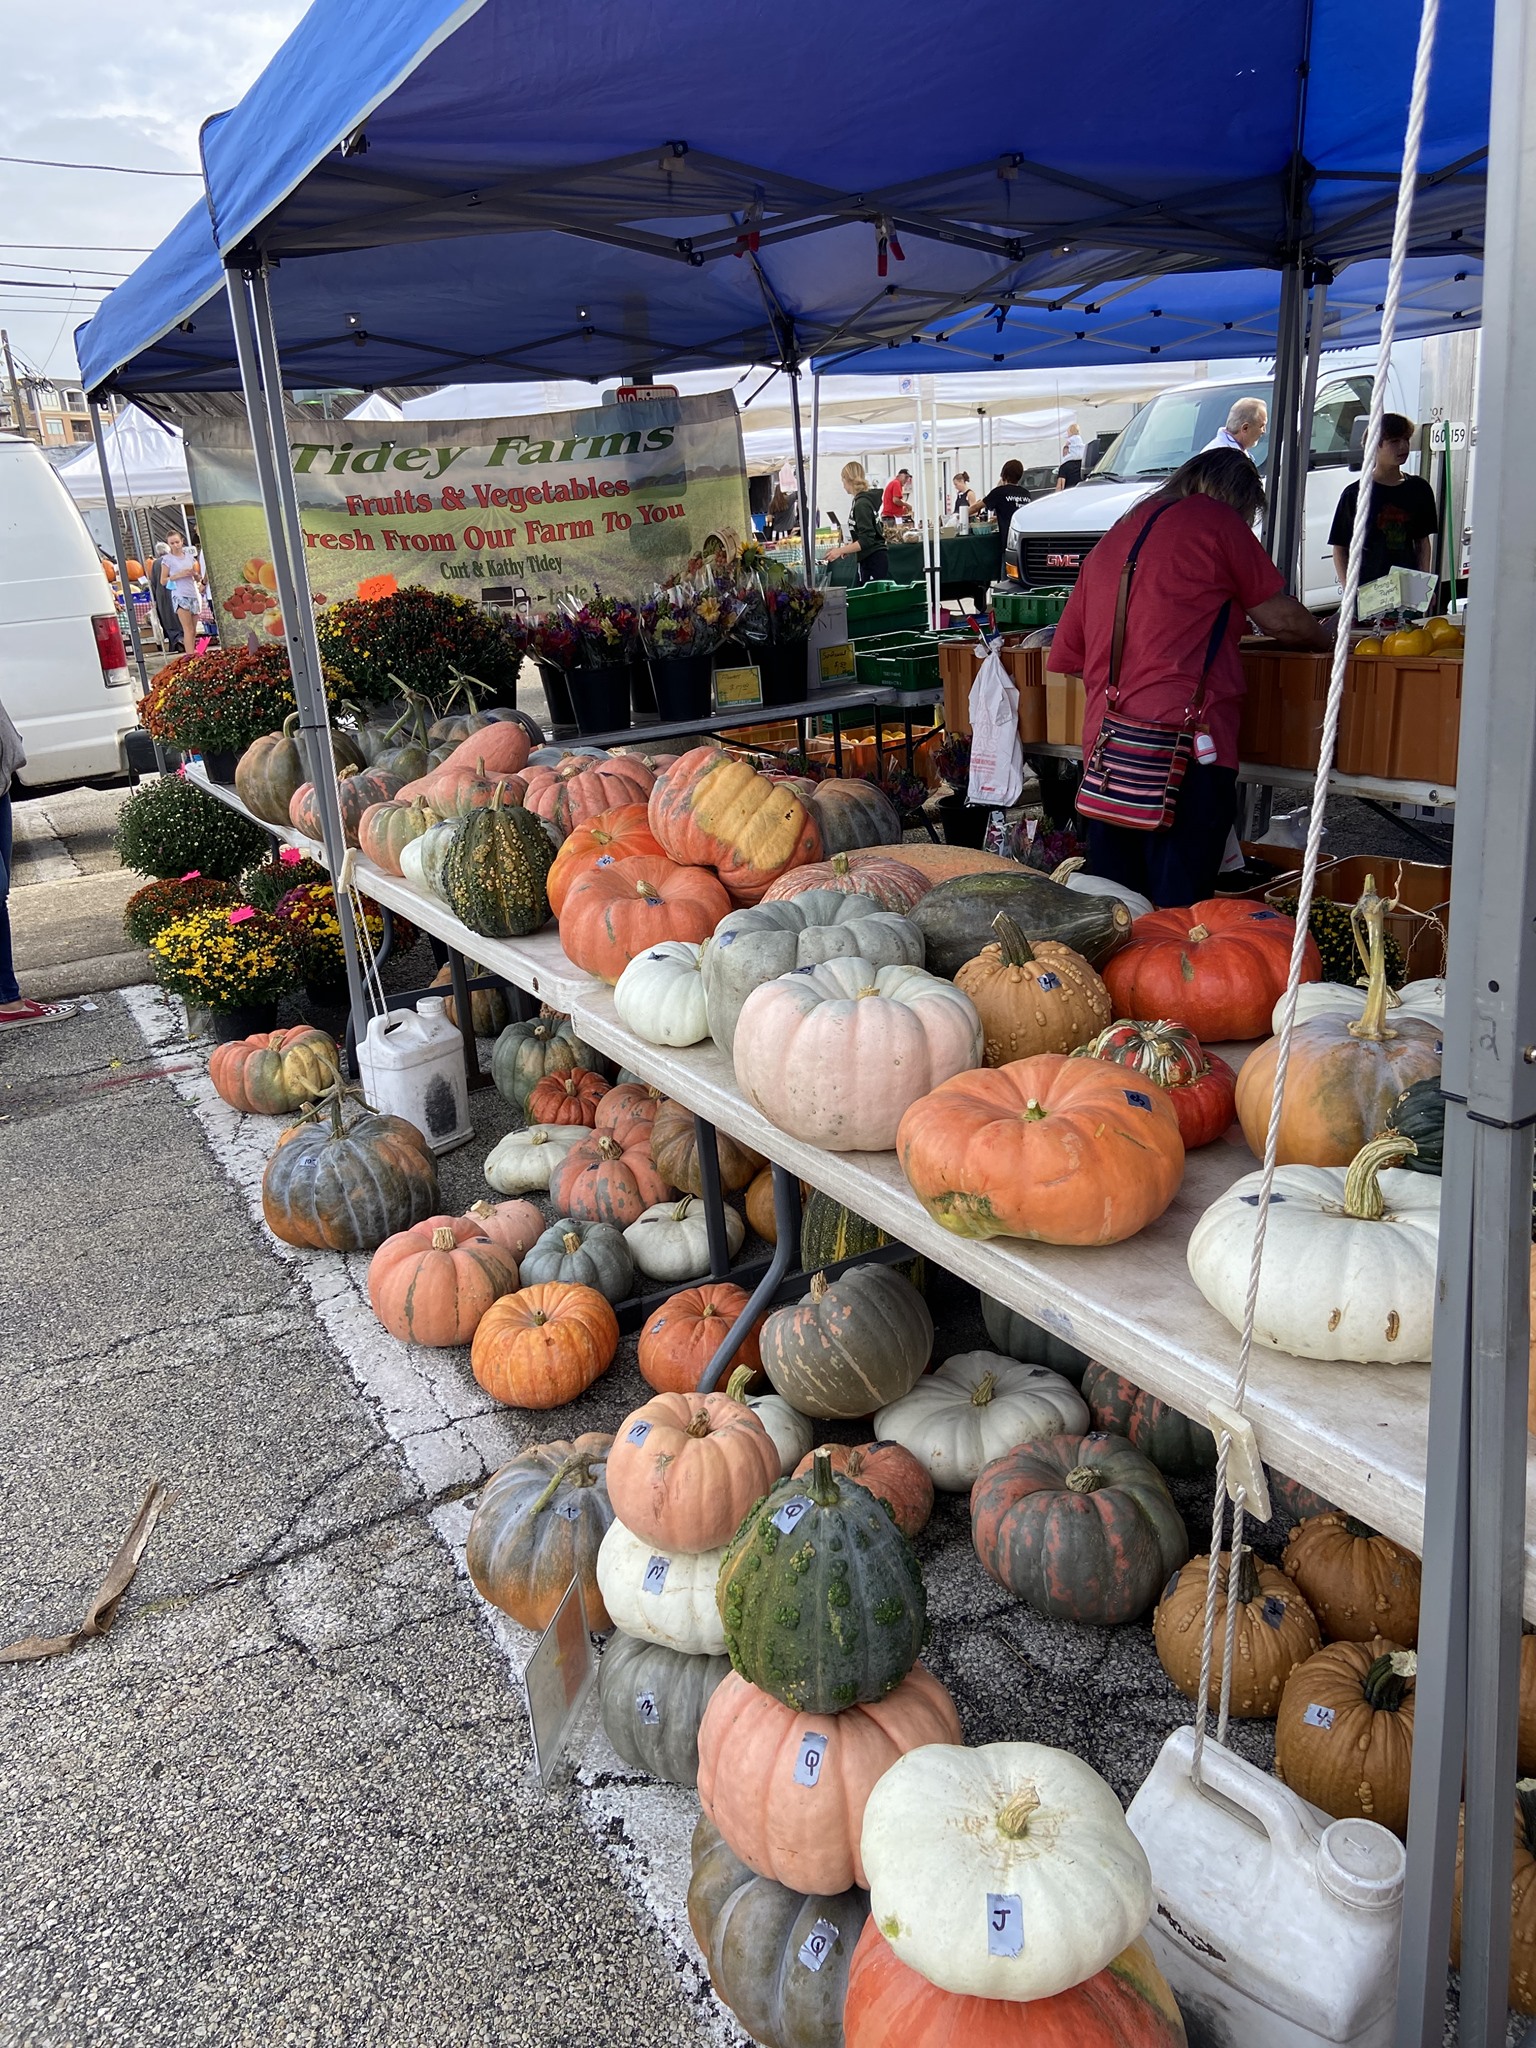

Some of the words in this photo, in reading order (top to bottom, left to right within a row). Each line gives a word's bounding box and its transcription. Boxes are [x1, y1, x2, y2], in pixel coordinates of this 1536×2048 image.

[1450, 429, 1465, 443] 159
[291, 440, 470, 480] Tidey
[484, 426, 675, 467] Farms
[345, 489, 433, 516] Fruits
[441, 485, 467, 511] &
[472, 477, 631, 514] Vegetables
[302, 529, 375, 551] resh
[381, 529, 457, 552] From
[463, 525, 517, 550] Our
[524, 519, 594, 545] Farm
[601, 511, 632, 533] To
[636, 503, 686, 526] You
[440, 562, 471, 580] Curt
[472, 561, 485, 577] &
[485, 557, 525, 579] Kathy
[527, 554, 563, 575] Tidey
[1047, 554, 1080, 567] GMC
[550, 585, 588, 602] table
[785, 1503, 803, 1519] Q
[805, 1749, 819, 1776] Q
[992, 1909, 1011, 1931] J
[810, 1935, 826, 1956] Q
